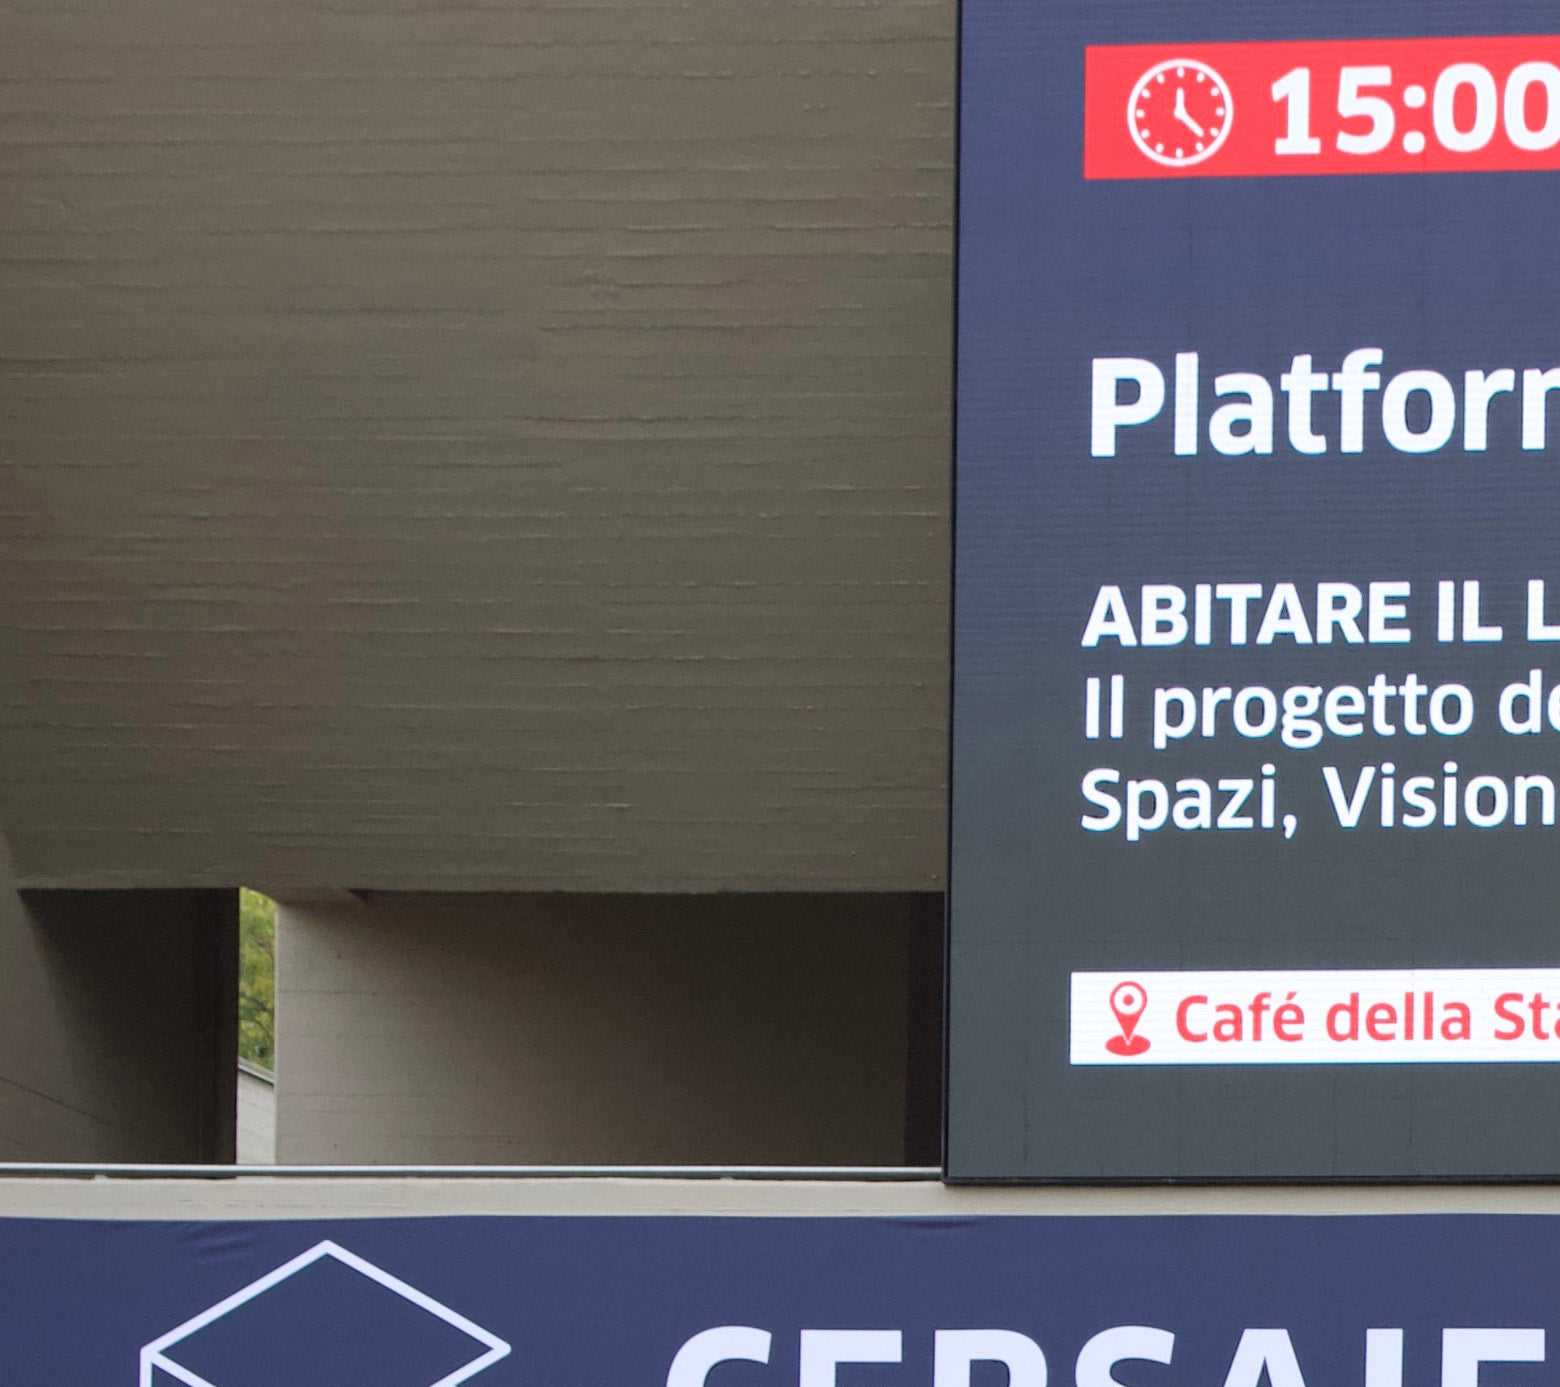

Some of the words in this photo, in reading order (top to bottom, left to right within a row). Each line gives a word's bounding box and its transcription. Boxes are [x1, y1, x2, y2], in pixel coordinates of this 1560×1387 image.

[1082, 582, 1410, 646] ABITARE
[1438, 581, 1502, 641] IL
[1086, 675, 1123, 738] Il
[1154, 674, 1473, 749] progetto
[1082, 764, 1296, 840] Spazi,
[1177, 993, 1304, 1042] Café
[1327, 992, 1470, 1041] della
